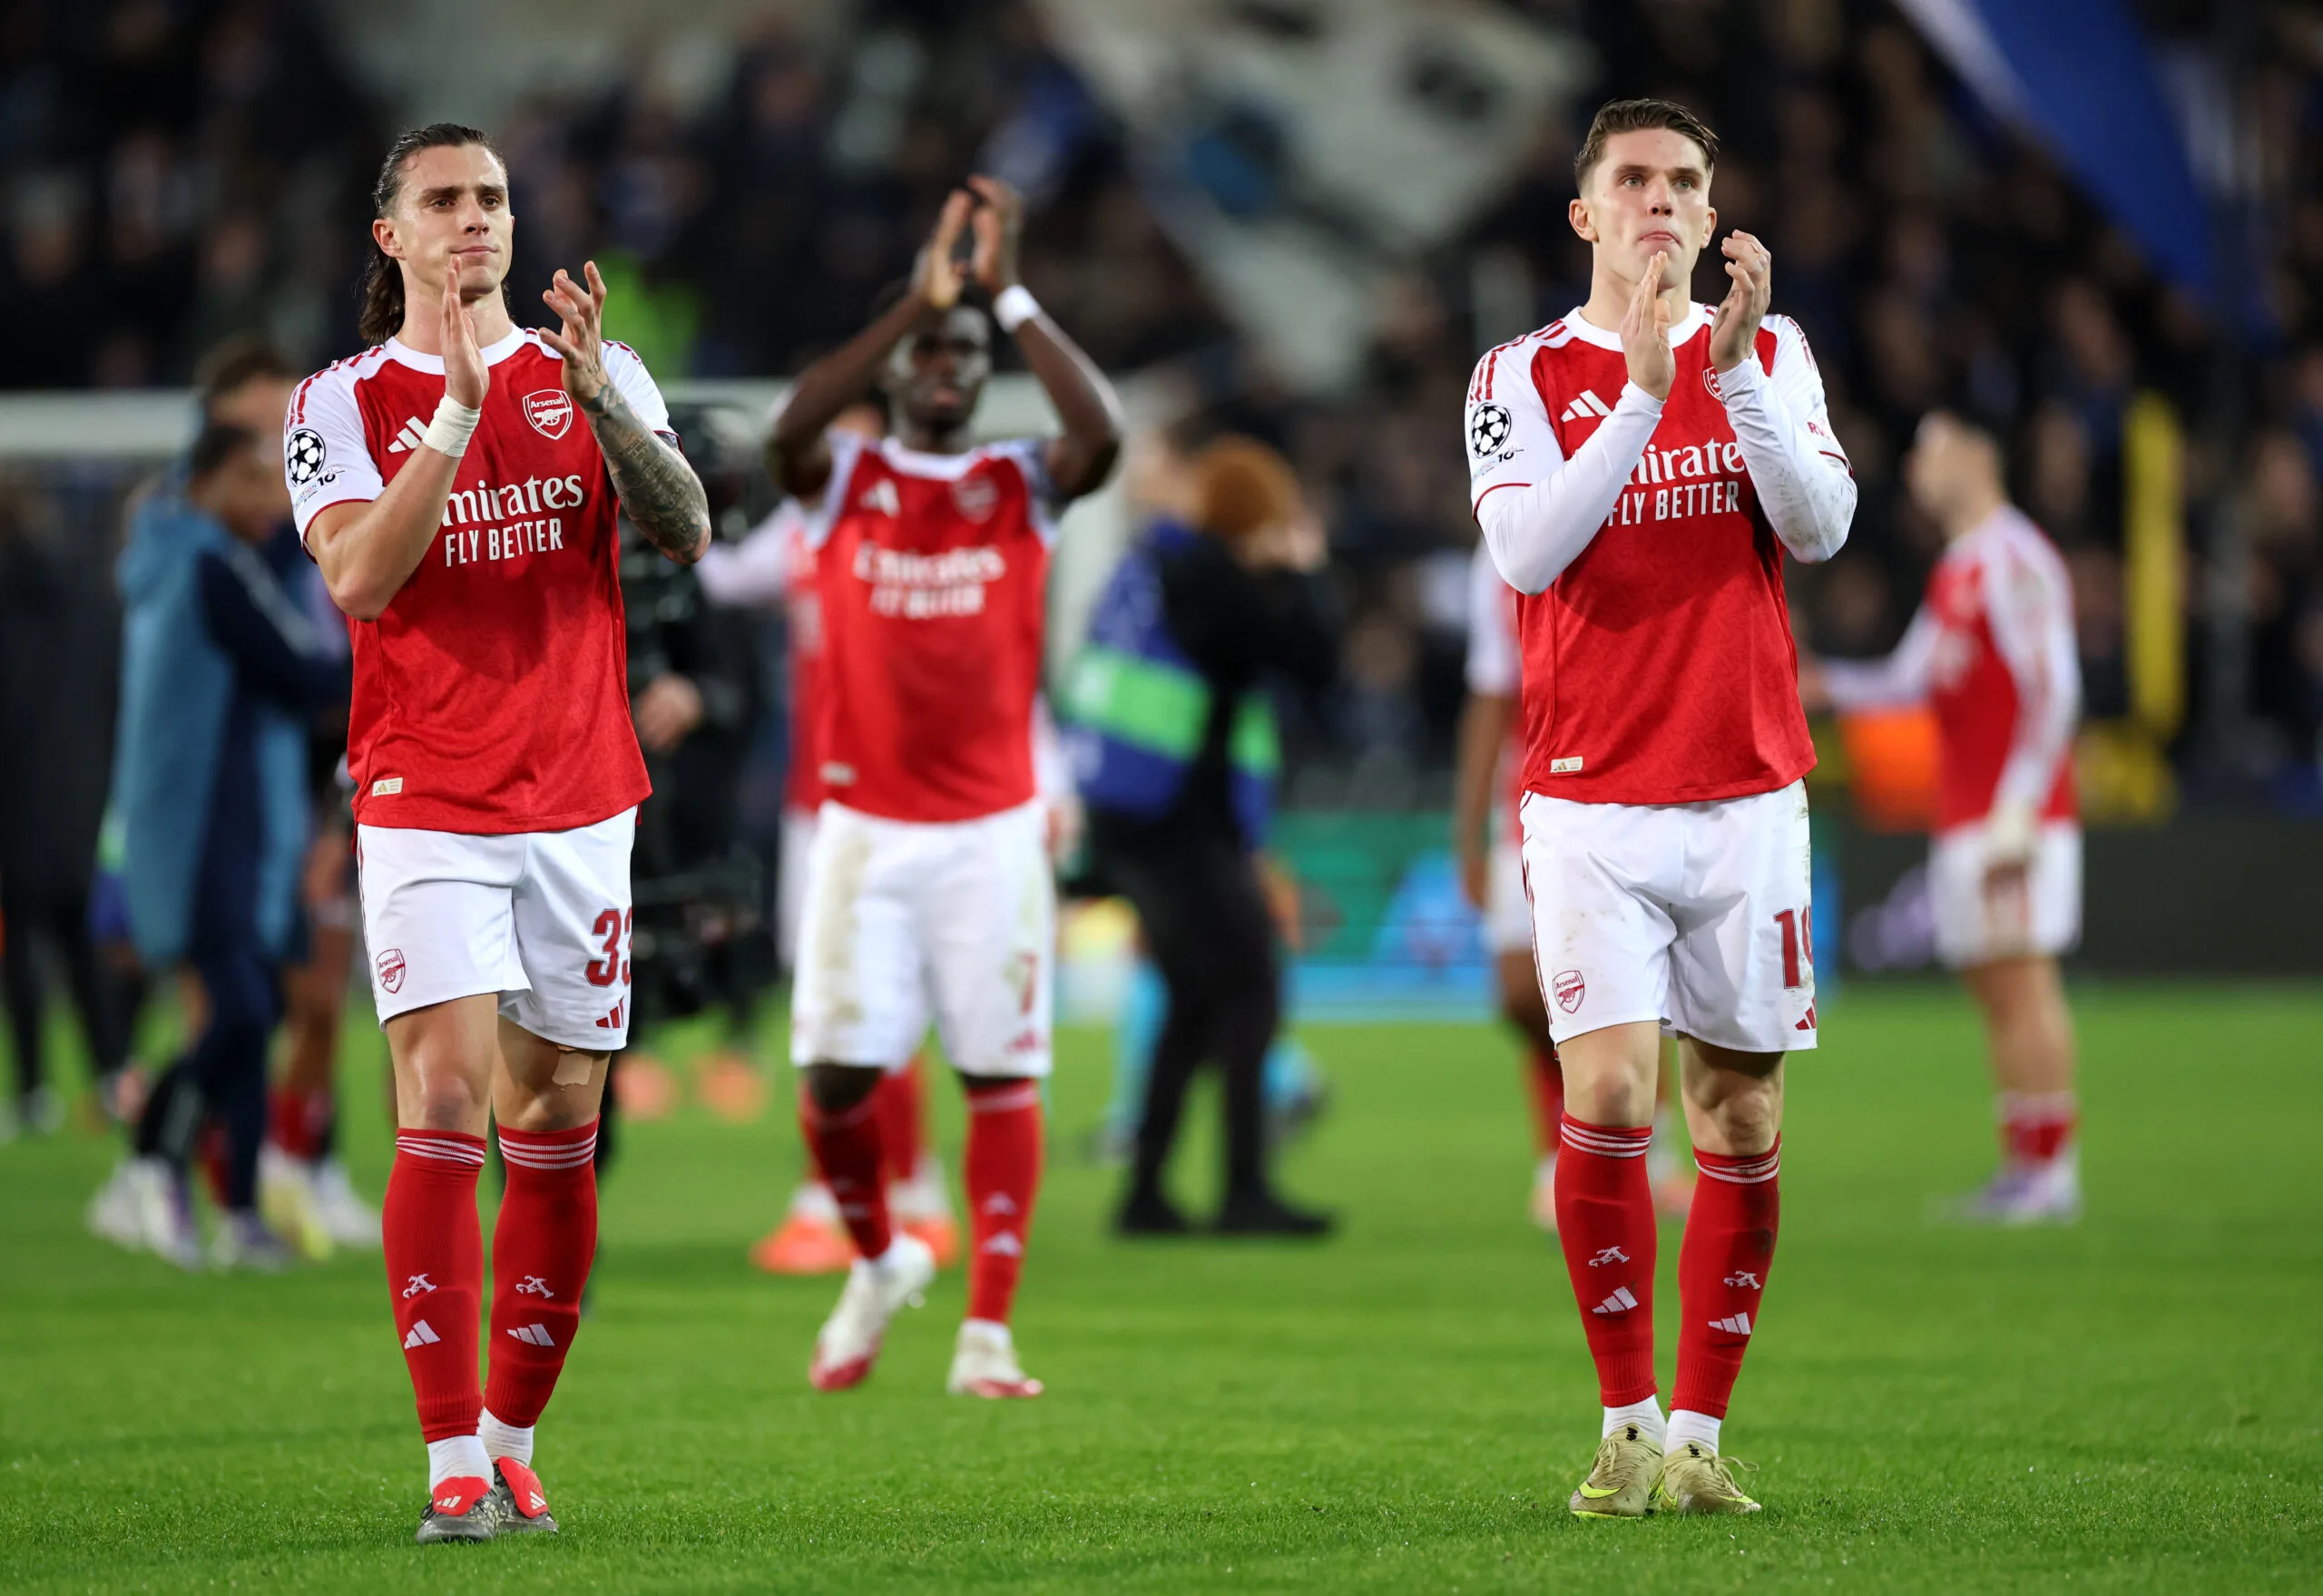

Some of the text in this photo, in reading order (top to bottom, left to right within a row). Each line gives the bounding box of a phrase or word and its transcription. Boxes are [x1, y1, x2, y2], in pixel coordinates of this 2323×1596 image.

[530, 396, 564, 408] Arsenal
[1625, 437, 1746, 485] irate
[442, 474, 583, 527] mirates
[1654, 481, 1740, 521] BETTER
[445, 517, 564, 567] FLY BETTER
